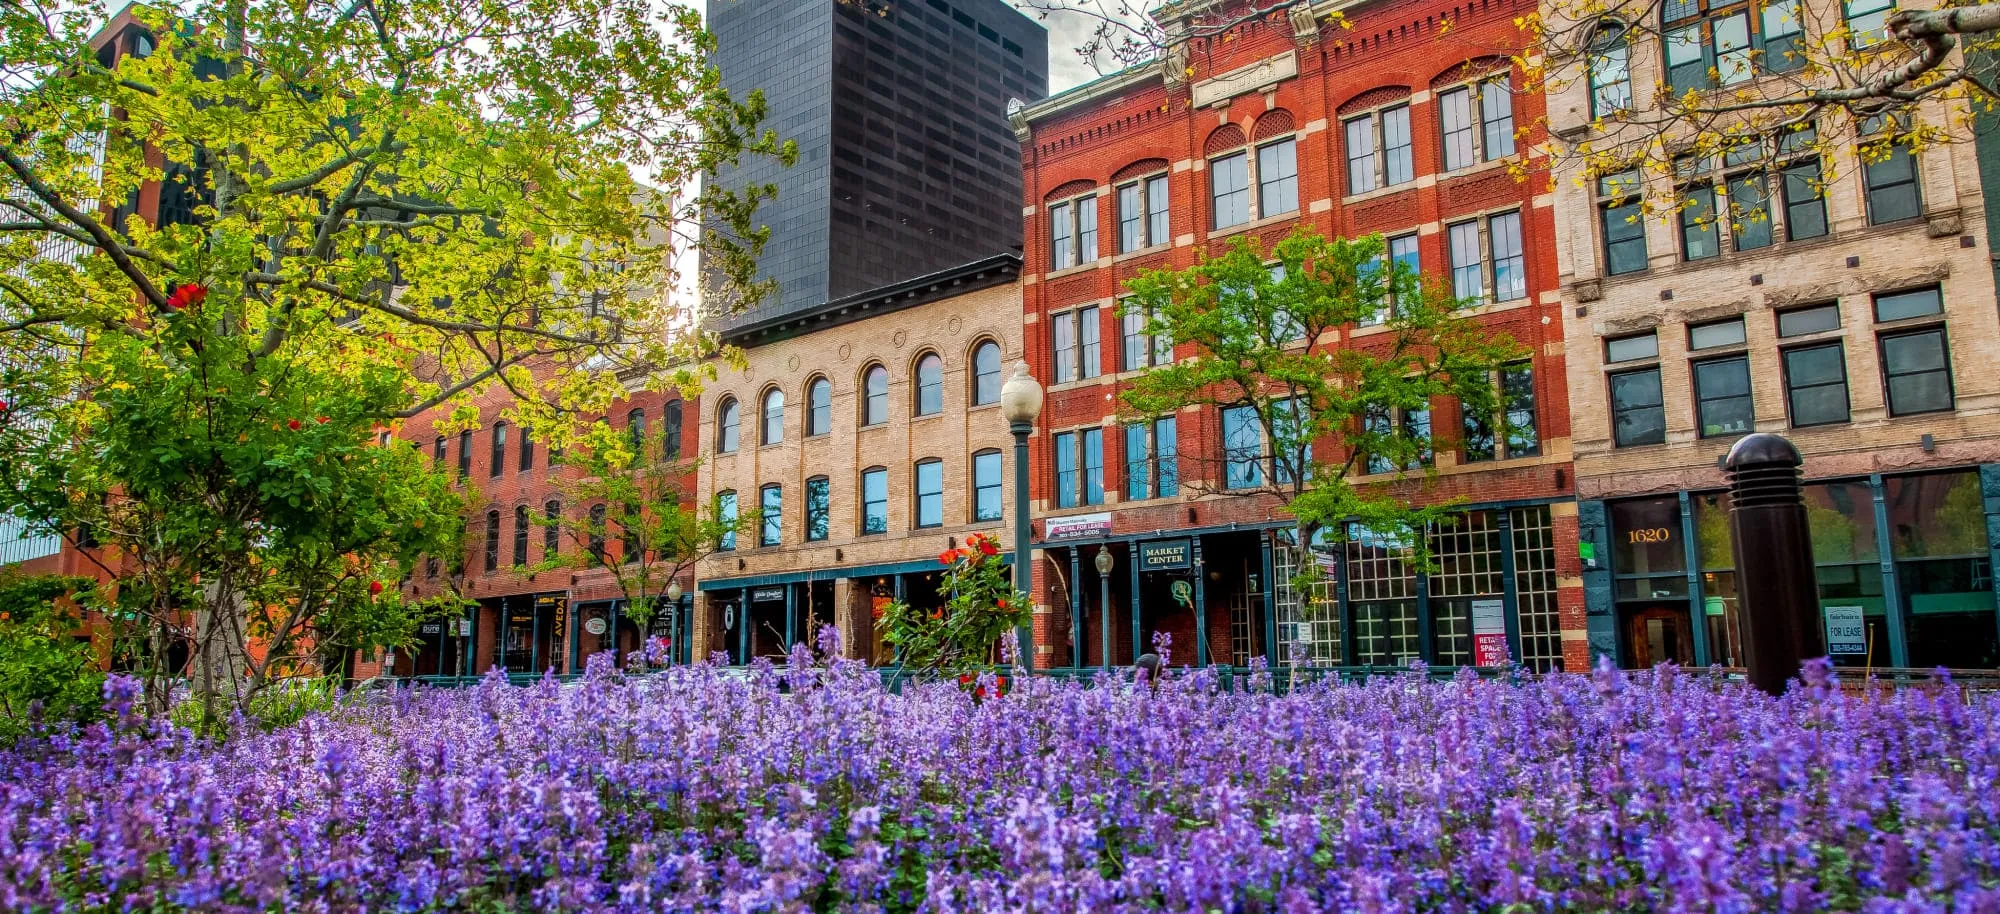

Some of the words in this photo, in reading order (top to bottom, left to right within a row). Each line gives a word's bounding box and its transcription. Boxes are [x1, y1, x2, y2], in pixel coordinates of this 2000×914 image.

[1088, 522, 1104, 530] LEASE
[1627, 527, 1670, 544] 1620
[1146, 546, 1185, 557] MARKET
[1147, 555, 1184, 565] CENTER
[555, 599, 565, 637] AVEDA
[1830, 627, 1842, 637] FOR
[1843, 626, 1863, 637] LEASE
